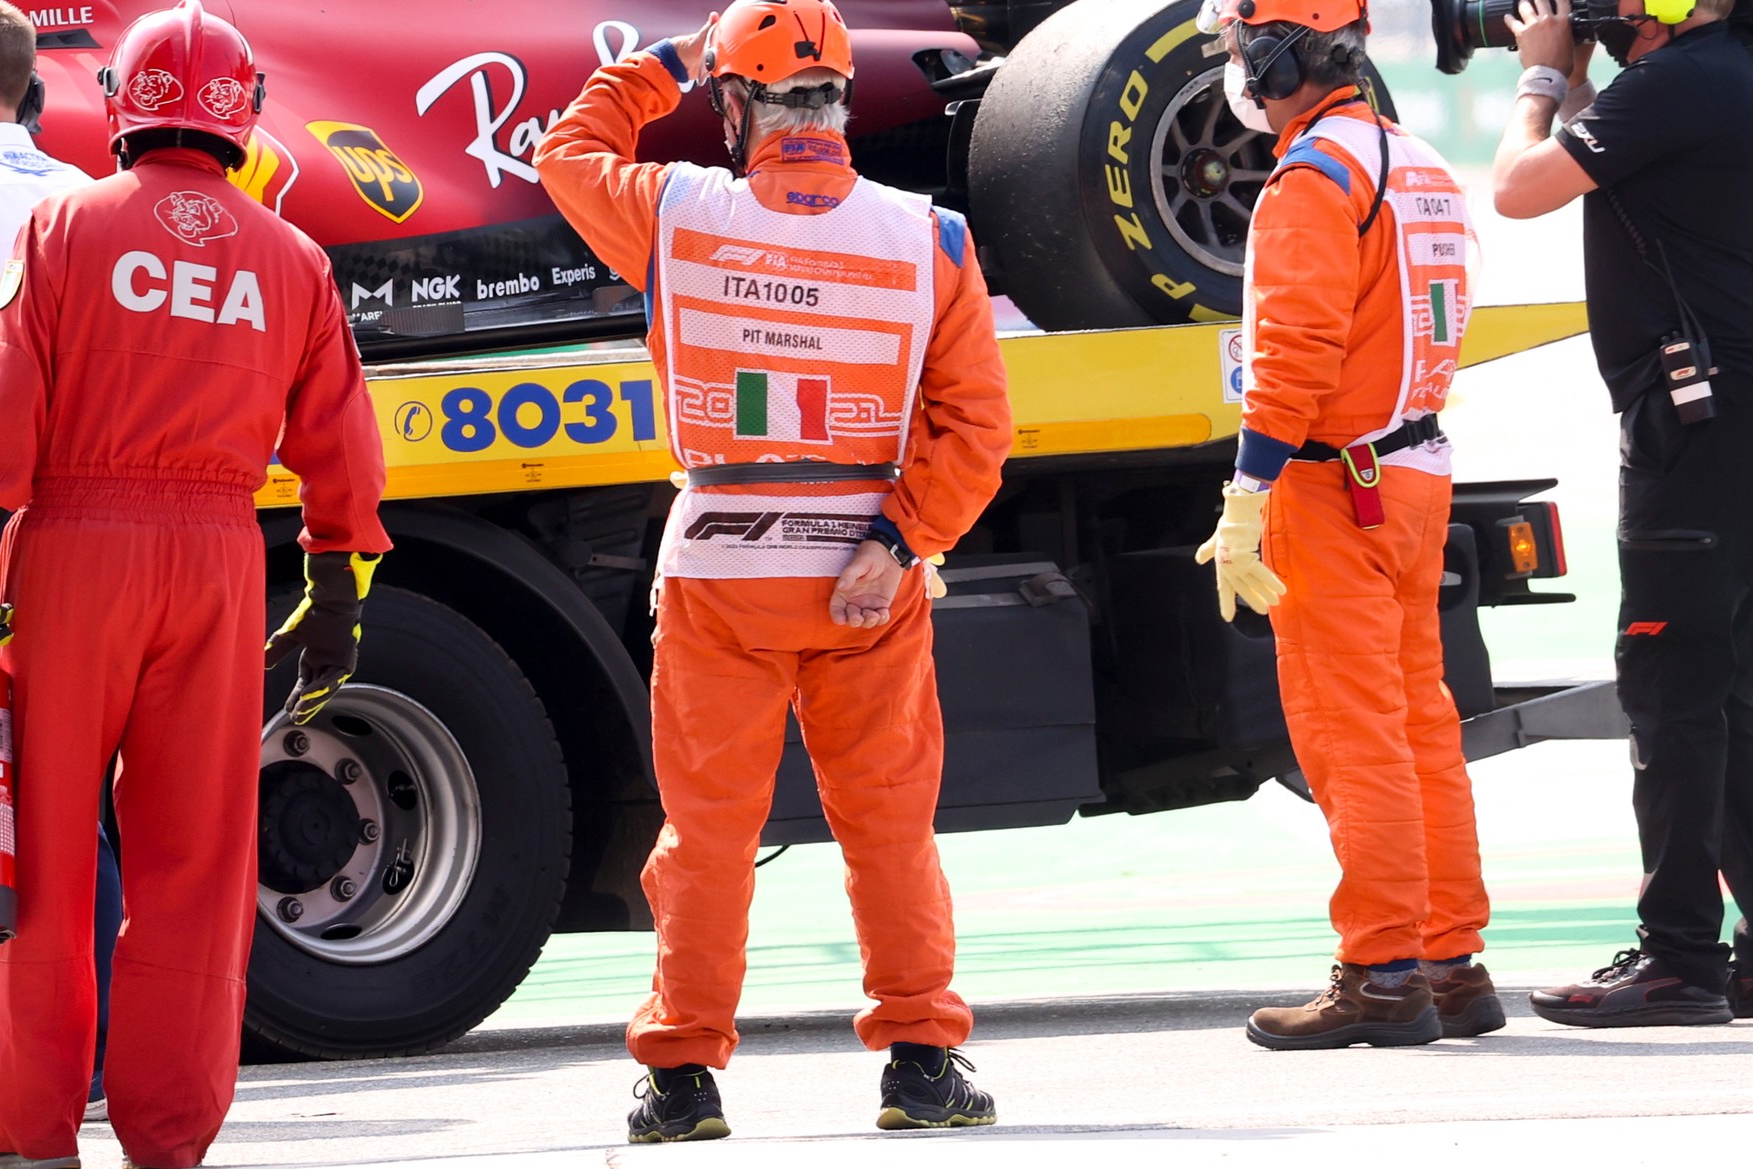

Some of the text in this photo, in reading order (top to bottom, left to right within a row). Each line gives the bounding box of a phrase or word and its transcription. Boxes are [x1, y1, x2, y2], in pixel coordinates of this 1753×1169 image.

[29, 6, 94, 27] MILLE
[1104, 70, 1153, 251] ZERO
[411, 273, 461, 302] NGK
[476, 273, 540, 299] brembo
[551, 264, 596, 287] Experis
[111, 250, 266, 333] CEA
[743, 328, 823, 350] PIT MARSHAL
[441, 379, 656, 452] 8031
[684, 511, 786, 542] F1
[781, 520, 830, 528] FORMULA
[1624, 622, 1668, 635] F1
